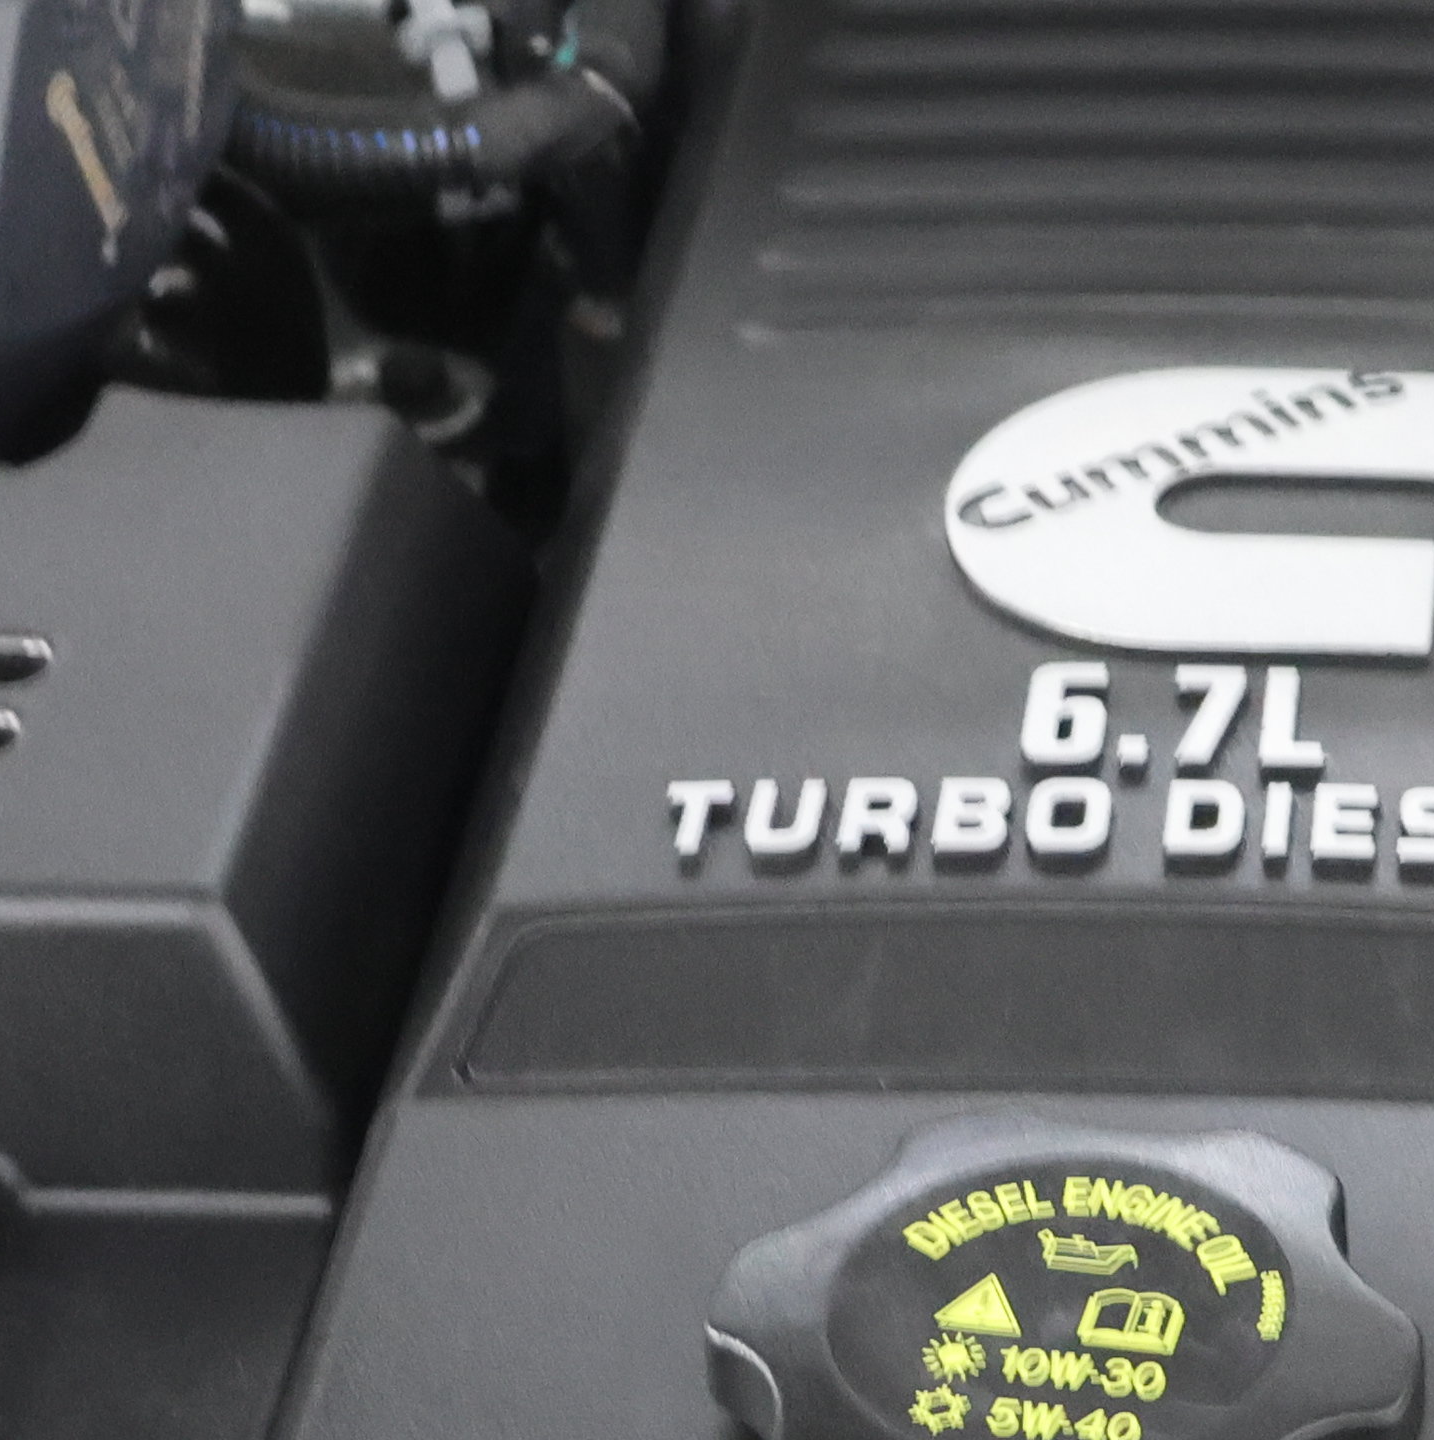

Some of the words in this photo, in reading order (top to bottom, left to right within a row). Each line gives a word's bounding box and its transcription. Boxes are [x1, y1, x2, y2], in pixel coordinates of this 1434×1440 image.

[958, 365, 1405, 528] Cummins
[1018, 660, 1332, 767] 6.7L
[666, 775, 1113, 855] TURBO
[902, 1180, 1056, 1261] DIESEL
[1062, 1175, 1222, 1252] ENGINE
[1195, 1233, 1258, 1296] OIL
[1000, 1344, 1167, 1403] 10W-30
